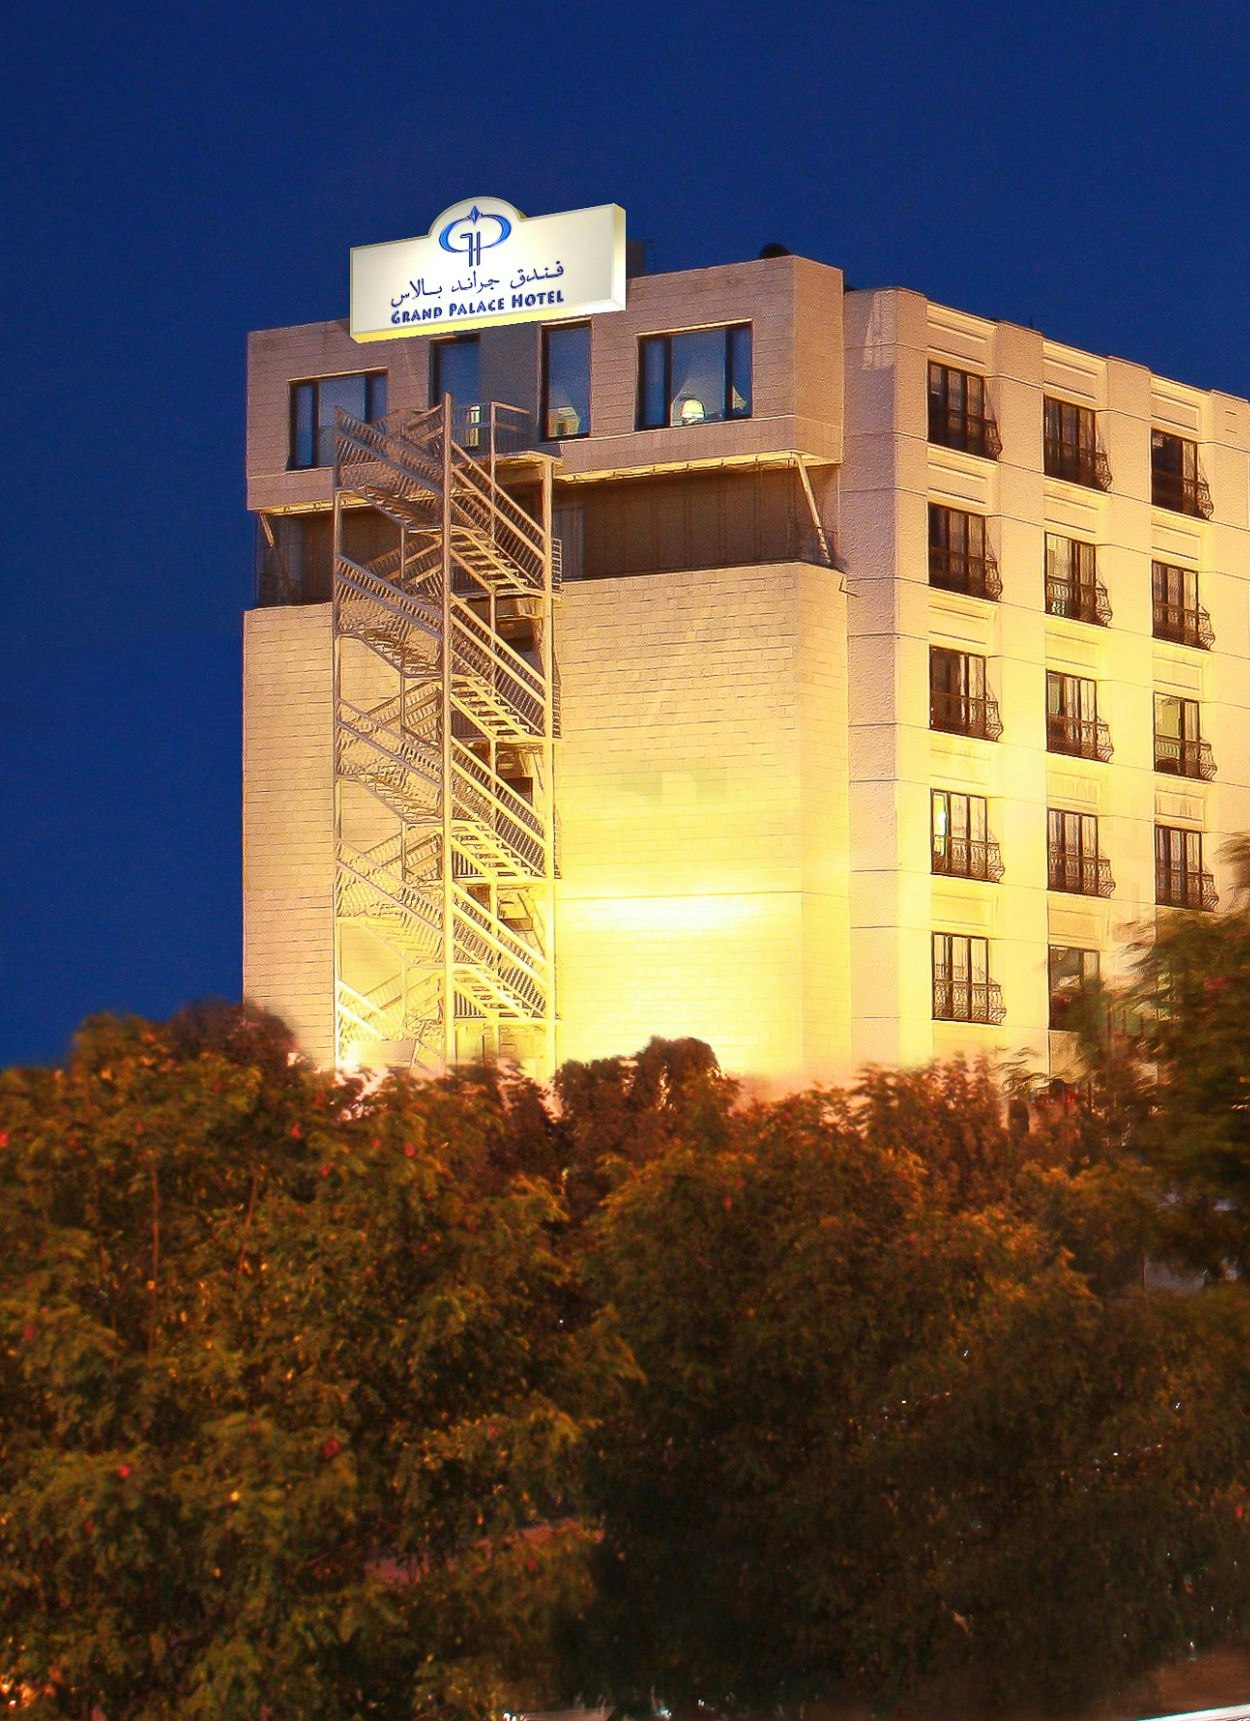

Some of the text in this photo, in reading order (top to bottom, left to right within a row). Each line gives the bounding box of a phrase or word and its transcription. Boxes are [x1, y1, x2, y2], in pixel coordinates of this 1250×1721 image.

[390, 260, 565, 308] فندق جراند بالاس
[390, 290, 565, 325] GRAND PALACE HOTEL
